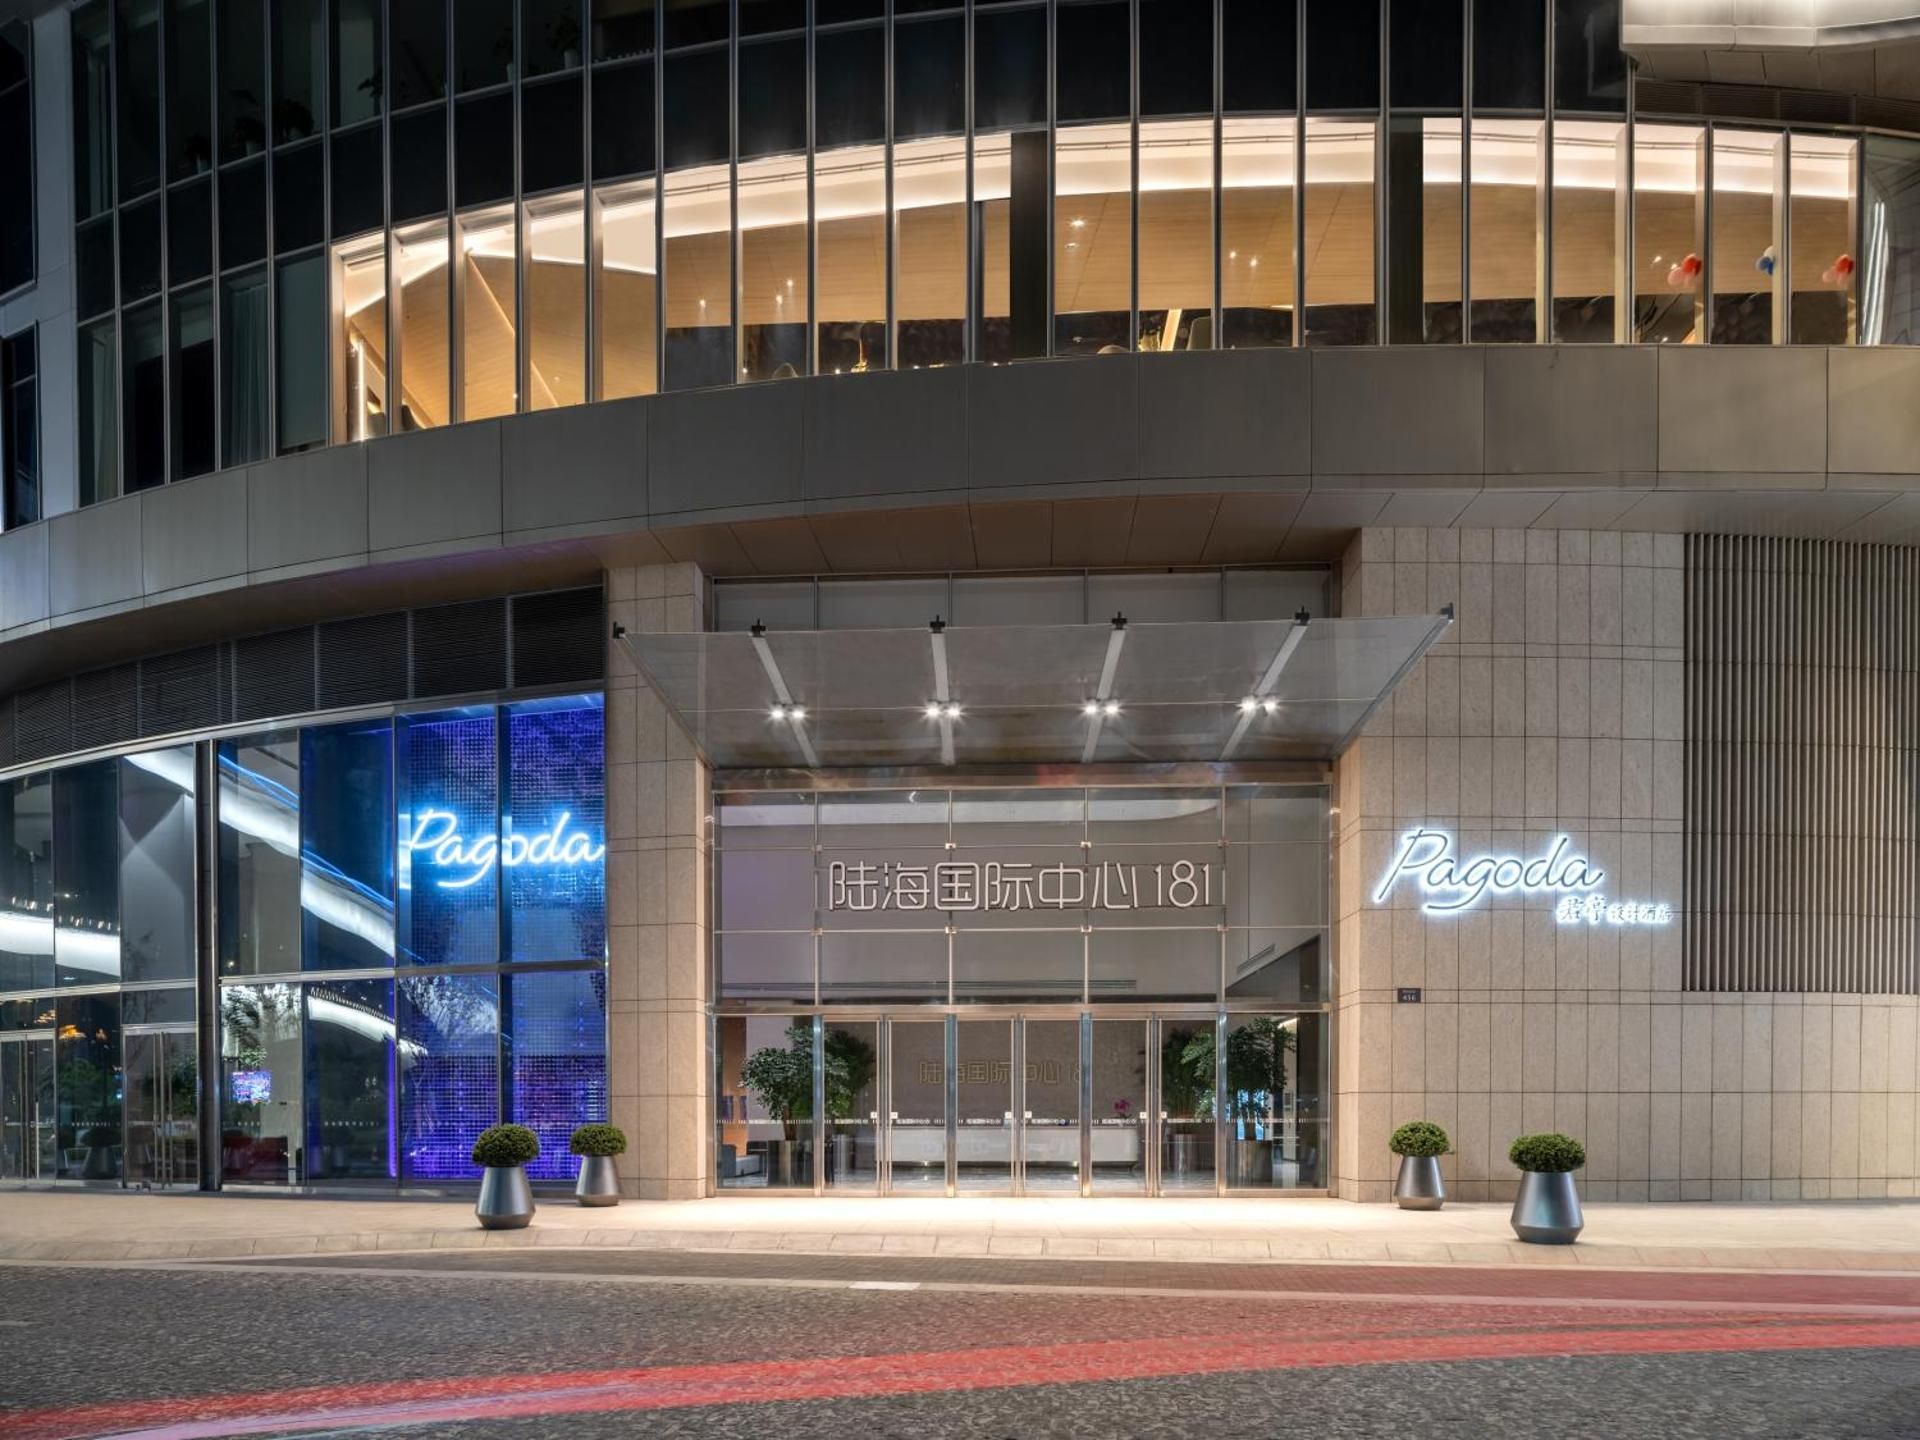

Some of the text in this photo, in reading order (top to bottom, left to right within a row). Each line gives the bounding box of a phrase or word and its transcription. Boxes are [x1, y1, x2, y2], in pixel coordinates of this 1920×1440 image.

[400, 808, 605, 888] Pagoda
[828, 859, 1211, 912] 陆海国际中心 181
[1372, 828, 1605, 912] Pagoda
